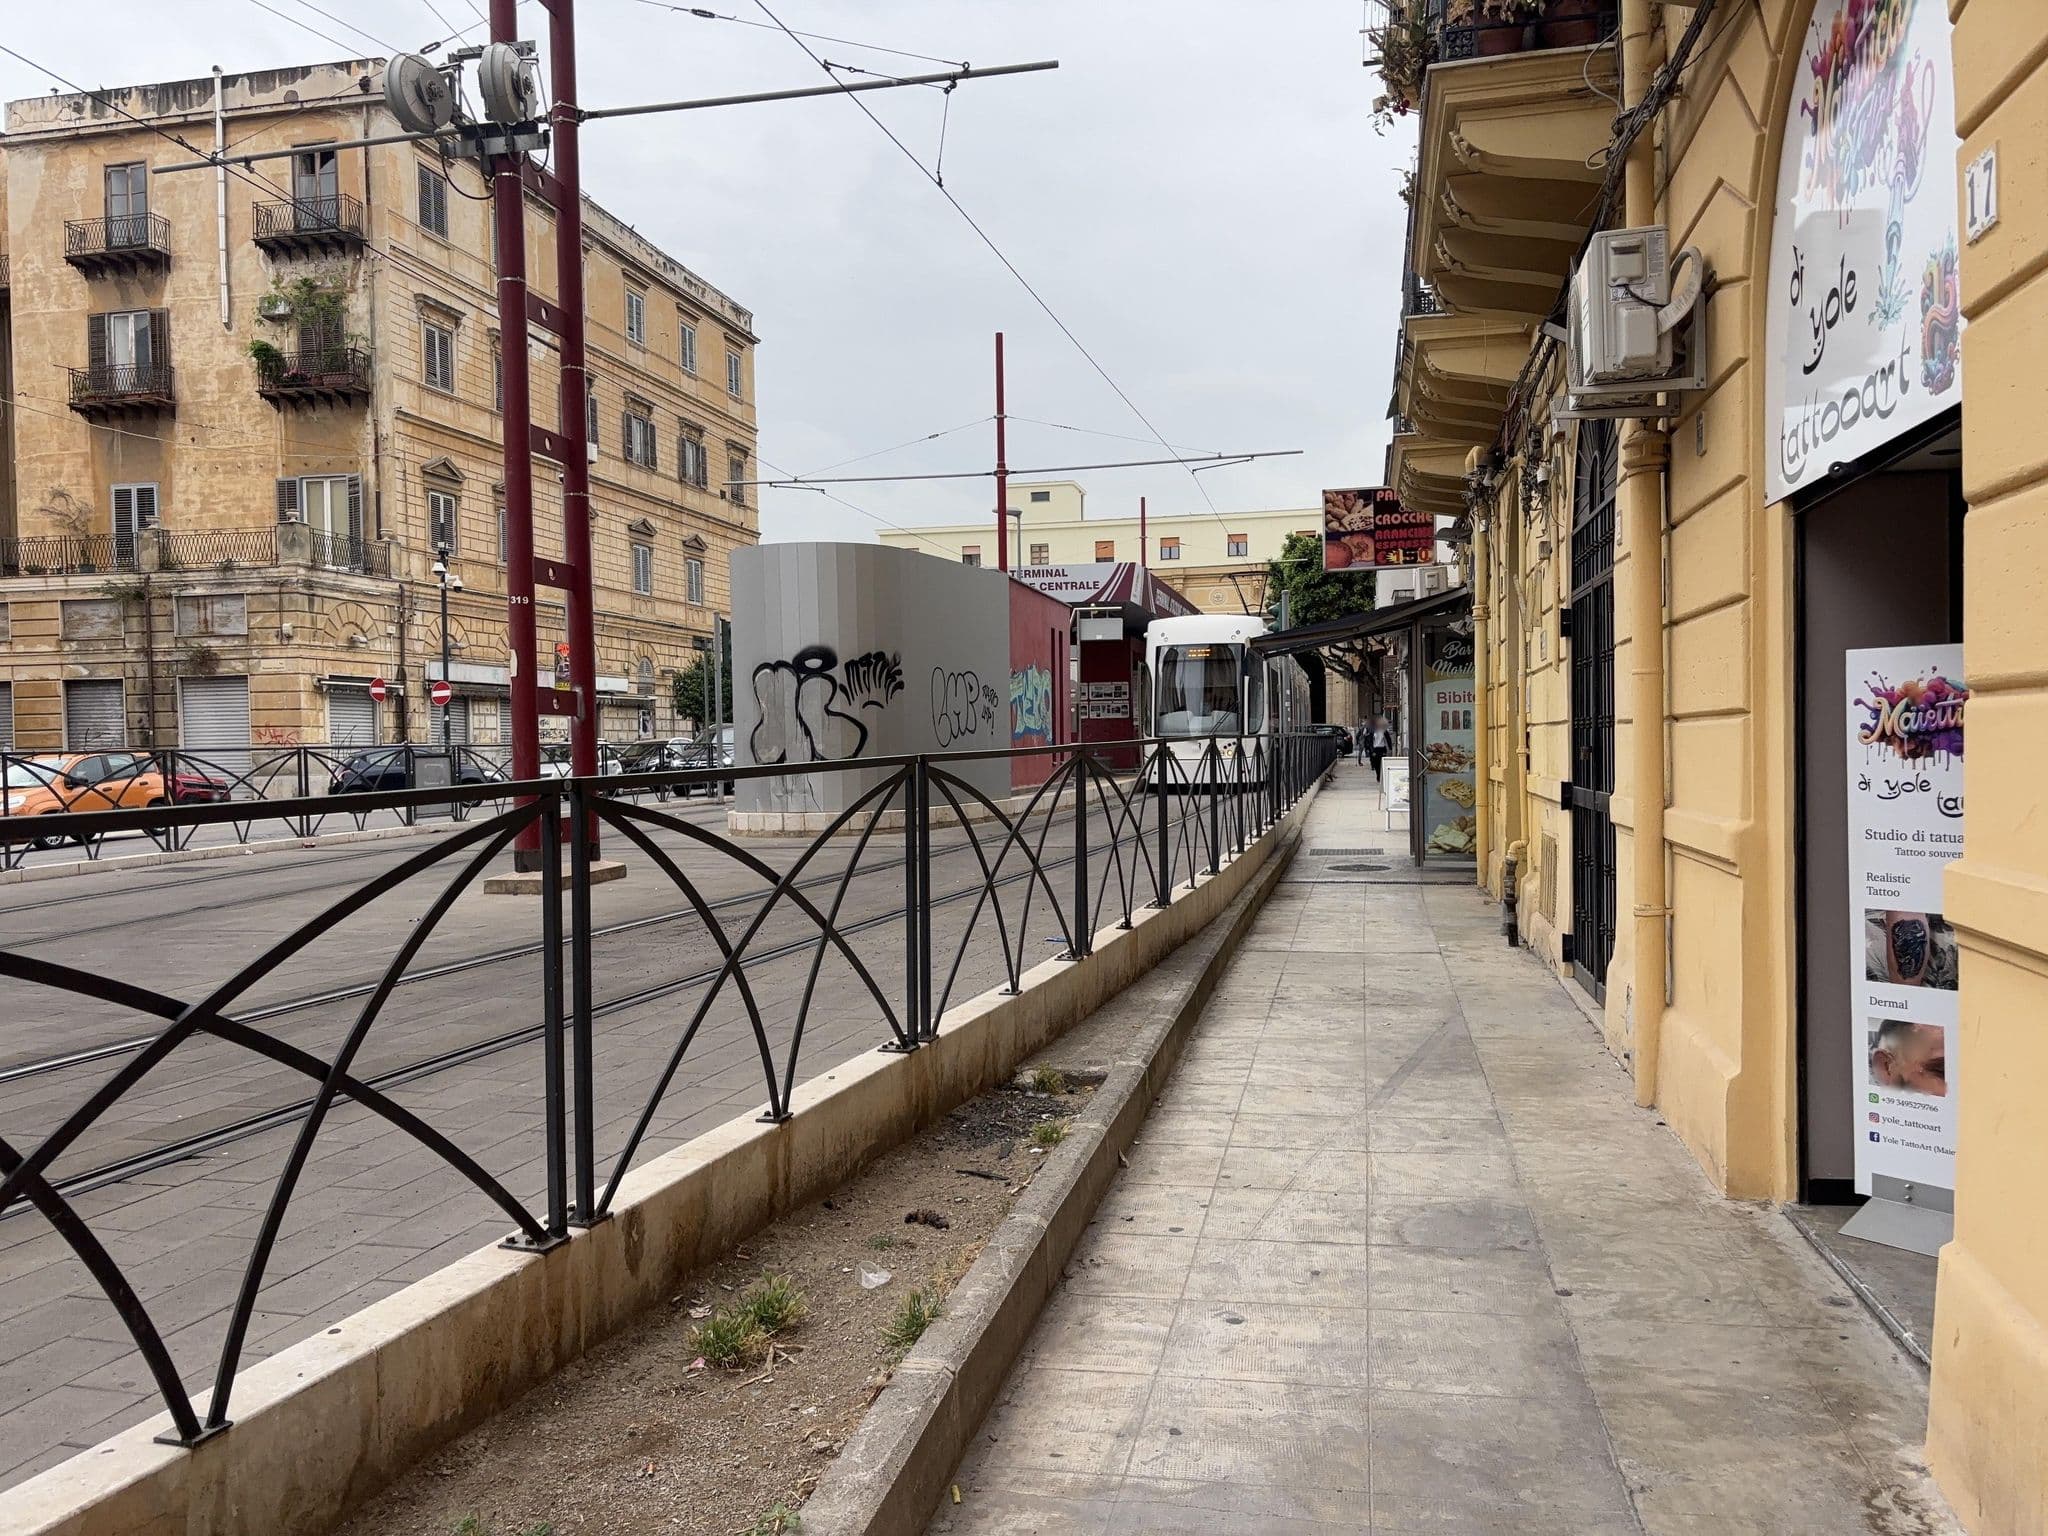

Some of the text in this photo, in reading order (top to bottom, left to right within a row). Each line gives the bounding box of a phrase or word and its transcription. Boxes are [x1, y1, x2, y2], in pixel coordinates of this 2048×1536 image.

[1967, 157, 1994, 229] 17
[1790, 245, 1805, 307] di
[1803, 252, 1858, 375] yole
[1780, 322, 1911, 485] tattooart
[1009, 568, 1068, 579] TERMINAL
[1040, 581, 1100, 591] CENTRALE
[510, 595, 529, 605] 319
[1442, 641, 1473, 659] Bar
[1858, 772, 1931, 800] di yole
[1865, 828, 1964, 844] Studio di tatua
[1894, 847, 1964, 859] Tattoo souven
[1866, 872, 1911, 884] Realistic
[1866, 886, 1900, 897] Tattoo
[1869, 995, 1909, 1010] Dermal
[1881, 1115, 1941, 1132] yole_tattooart
[1883, 1135, 1899, 1145] Yole
[1900, 1138, 1932, 1152] TattoArt
